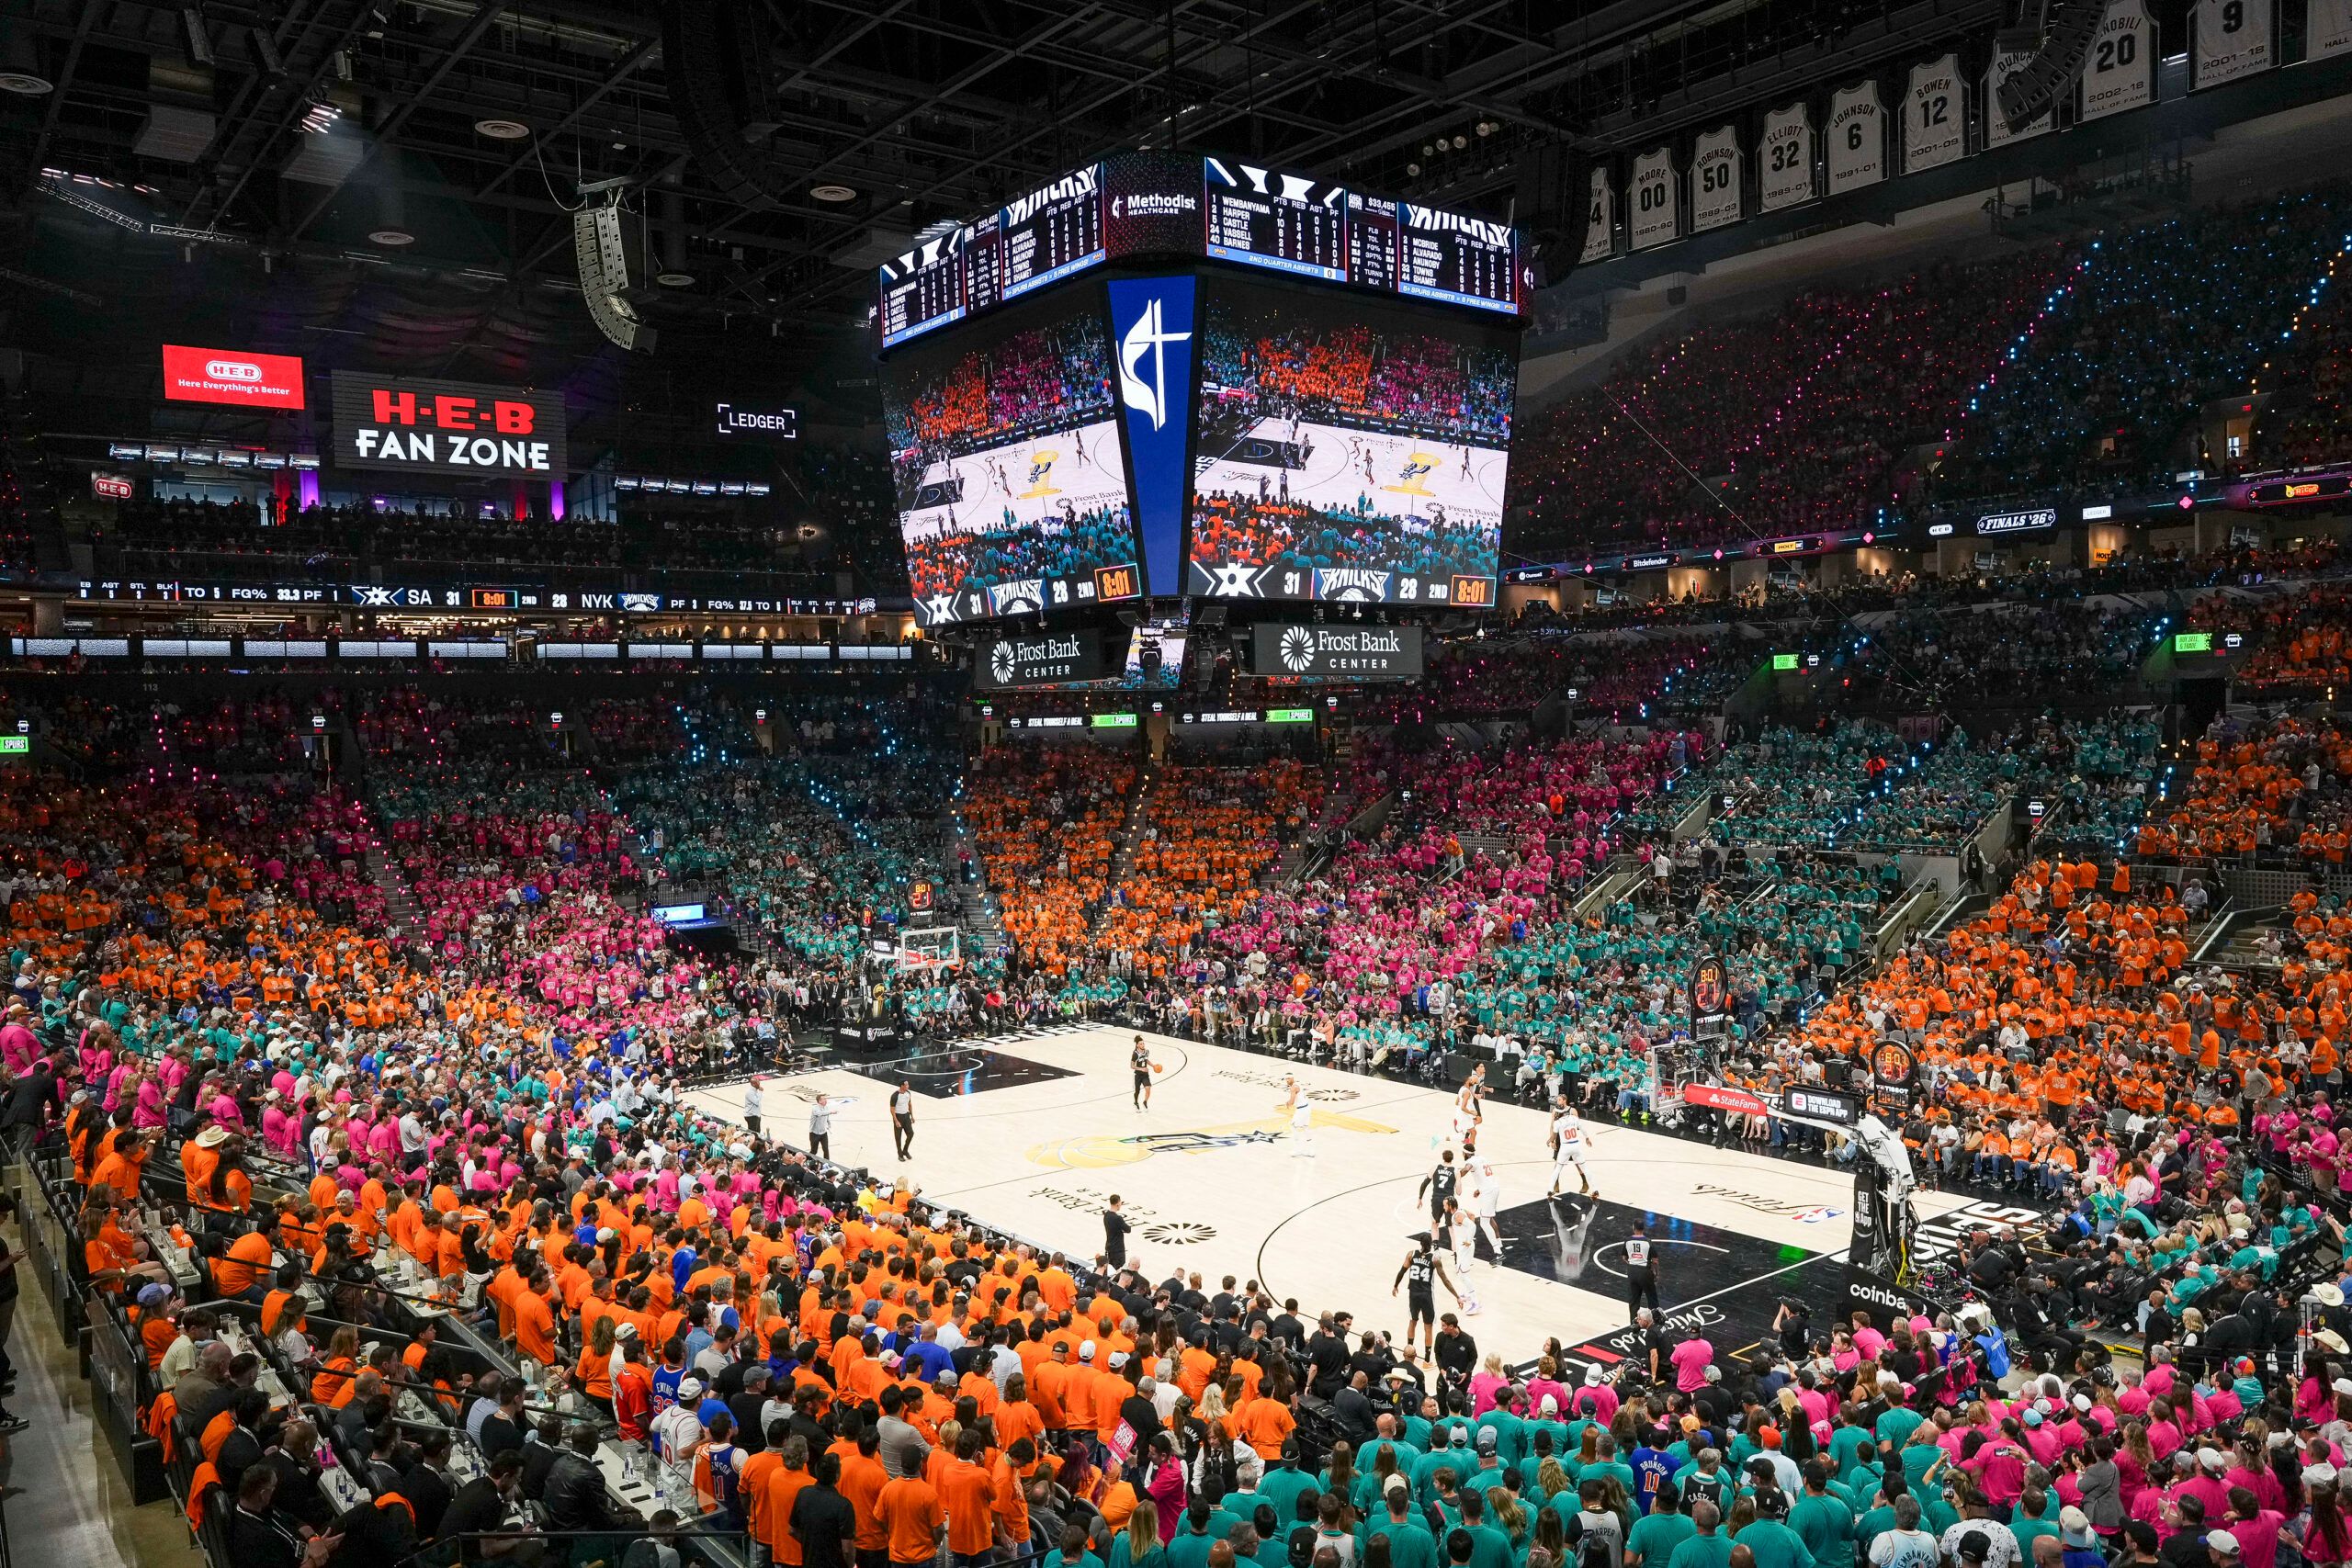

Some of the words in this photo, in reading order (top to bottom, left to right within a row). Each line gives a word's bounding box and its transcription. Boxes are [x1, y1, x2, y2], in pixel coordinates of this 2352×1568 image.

[2222, 0, 2245, 34] 9
[2097, 33, 2137, 74] 20
[2203, 46, 2265, 71] 2001-18
[1917, 79, 1951, 98] BOWEN
[2088, 81, 2144, 103] 2002-18
[1833, 102, 1876, 129] JOHNSON
[1920, 96, 1947, 129] 12
[1768, 125, 1804, 143] ELLIOTT
[1848, 123, 1861, 151] 6
[1911, 138, 1959, 158] 2001-09
[1697, 148, 1735, 170] ROBINSON
[1771, 141, 1800, 173] 32
[1638, 169, 1666, 185] MOORE
[1702, 163, 1729, 193] 50
[1835, 163, 1876, 181] 1991-01
[1127, 193, 1195, 209] Methodist
[1222, 196, 1271, 214] WEMBANYAMA
[1641, 183, 1666, 211] 00
[1128, 208, 1179, 216] HEALTHCARE
[1223, 207, 1250, 220] HARPER
[1273, 196, 1287, 206] PTS
[1292, 200, 1306, 209] REB
[1309, 205, 1323, 213] AST
[1329, 209, 1339, 217] PF
[1223, 217, 1249, 230] CASTLE
[1210, 224, 1219, 234] 24
[1223, 227, 1252, 242] VASSELL
[1210, 235, 1220, 244] 40
[1224, 237, 1250, 250] BARNES
[1412, 237, 1439, 251] MCBRIDE
[1412, 247, 1442, 261] ALVARADO
[1263, 256, 1292, 269] QUARTER
[1293, 262, 1318, 274] ASSISTS
[1413, 265, 1434, 277] TOWNS
[1413, 275, 1437, 287] SHAMET
[1411, 287, 1430, 297] SPURS
[1430, 290, 1455, 300] ASSISTS
[178, 378, 200, 389] Here
[203, 381, 259, 394] Everything's
[261, 386, 289, 396] Better
[371, 389, 535, 436] H-E-B
[729, 412, 785, 430] LEDGER
[356, 427, 435, 464] FAN
[447, 435, 550, 471] ZONE
[1984, 514, 2026, 530] FINALS
[2029, 513, 2047, 525] '26
[1633, 556, 1668, 568] Bitdefender
[185, 587, 205, 597] TO
[214, 587, 220, 599] 5
[232, 588, 266, 600] FG%
[277, 588, 300, 601] 33.3
[303, 591, 322, 600] PF
[970, 593, 982, 615] 31
[1052, 581, 1069, 604] 28
[1077, 581, 1095, 599] 2ND
[1102, 570, 1131, 597] 8:01
[1283, 571, 1300, 594] 31
[1399, 578, 1418, 600] 28
[1429, 583, 1448, 600] 2ND
[1457, 581, 1487, 604] 8:01
[407, 590, 433, 605] SA
[447, 591, 460, 605] 31
[483, 592, 505, 606] 8:01
[521, 595, 537, 605] 2ND
[552, 593, 567, 608] 28
[582, 594, 613, 609] NYK
[671, 599, 685, 608] PF
[707, 601, 734, 610] FG%
[755, 602, 770, 611] TO
[1317, 630, 1358, 653] Frost
[1361, 630, 1401, 653] Bank
[1016, 641, 1045, 666] Frost
[1047, 637, 1081, 660] Bank
[1024, 664, 1071, 680] CENTER
[1329, 658, 1388, 670] CENTER
[1201, 714, 1216, 722] STEAL
[1216, 712, 1240, 722] YOURSELF
[4, 739, 26, 750] SPURS
[915, 884, 930, 893] 8:01
[1701, 966, 1720, 983] 8:01
[1697, 982, 1717, 1008] 21
[1704, 1013, 1724, 1023] TISSOT
[841, 1027, 861, 1038] coinbase
[872, 1027, 895, 1042] Finals
[1885, 1052, 1907, 1065] 8:01
[1807, 1094, 1841, 1109] DOWNLOAD
[1807, 1105, 1818, 1113] THE
[1819, 1106, 1833, 1115] ESPN
[1833, 1108, 1848, 1118] APP
[1564, 1128, 1577, 1140] 00
[1438, 1176, 1449, 1189] 7
[1858, 1190, 1869, 1199] GET
[1858, 1201, 1869, 1213] THE
[1860, 1214, 1871, 1227] App
[1633, 1243, 1641, 1253] 19
[1412, 1258, 1430, 1267] VASSELL
[1409, 1266, 1430, 1282] 24
[656, 1382, 674, 1397] EWING
[1639, 1460, 1668, 1476] BRUNSON
[1644, 1471, 1660, 1493] 11
